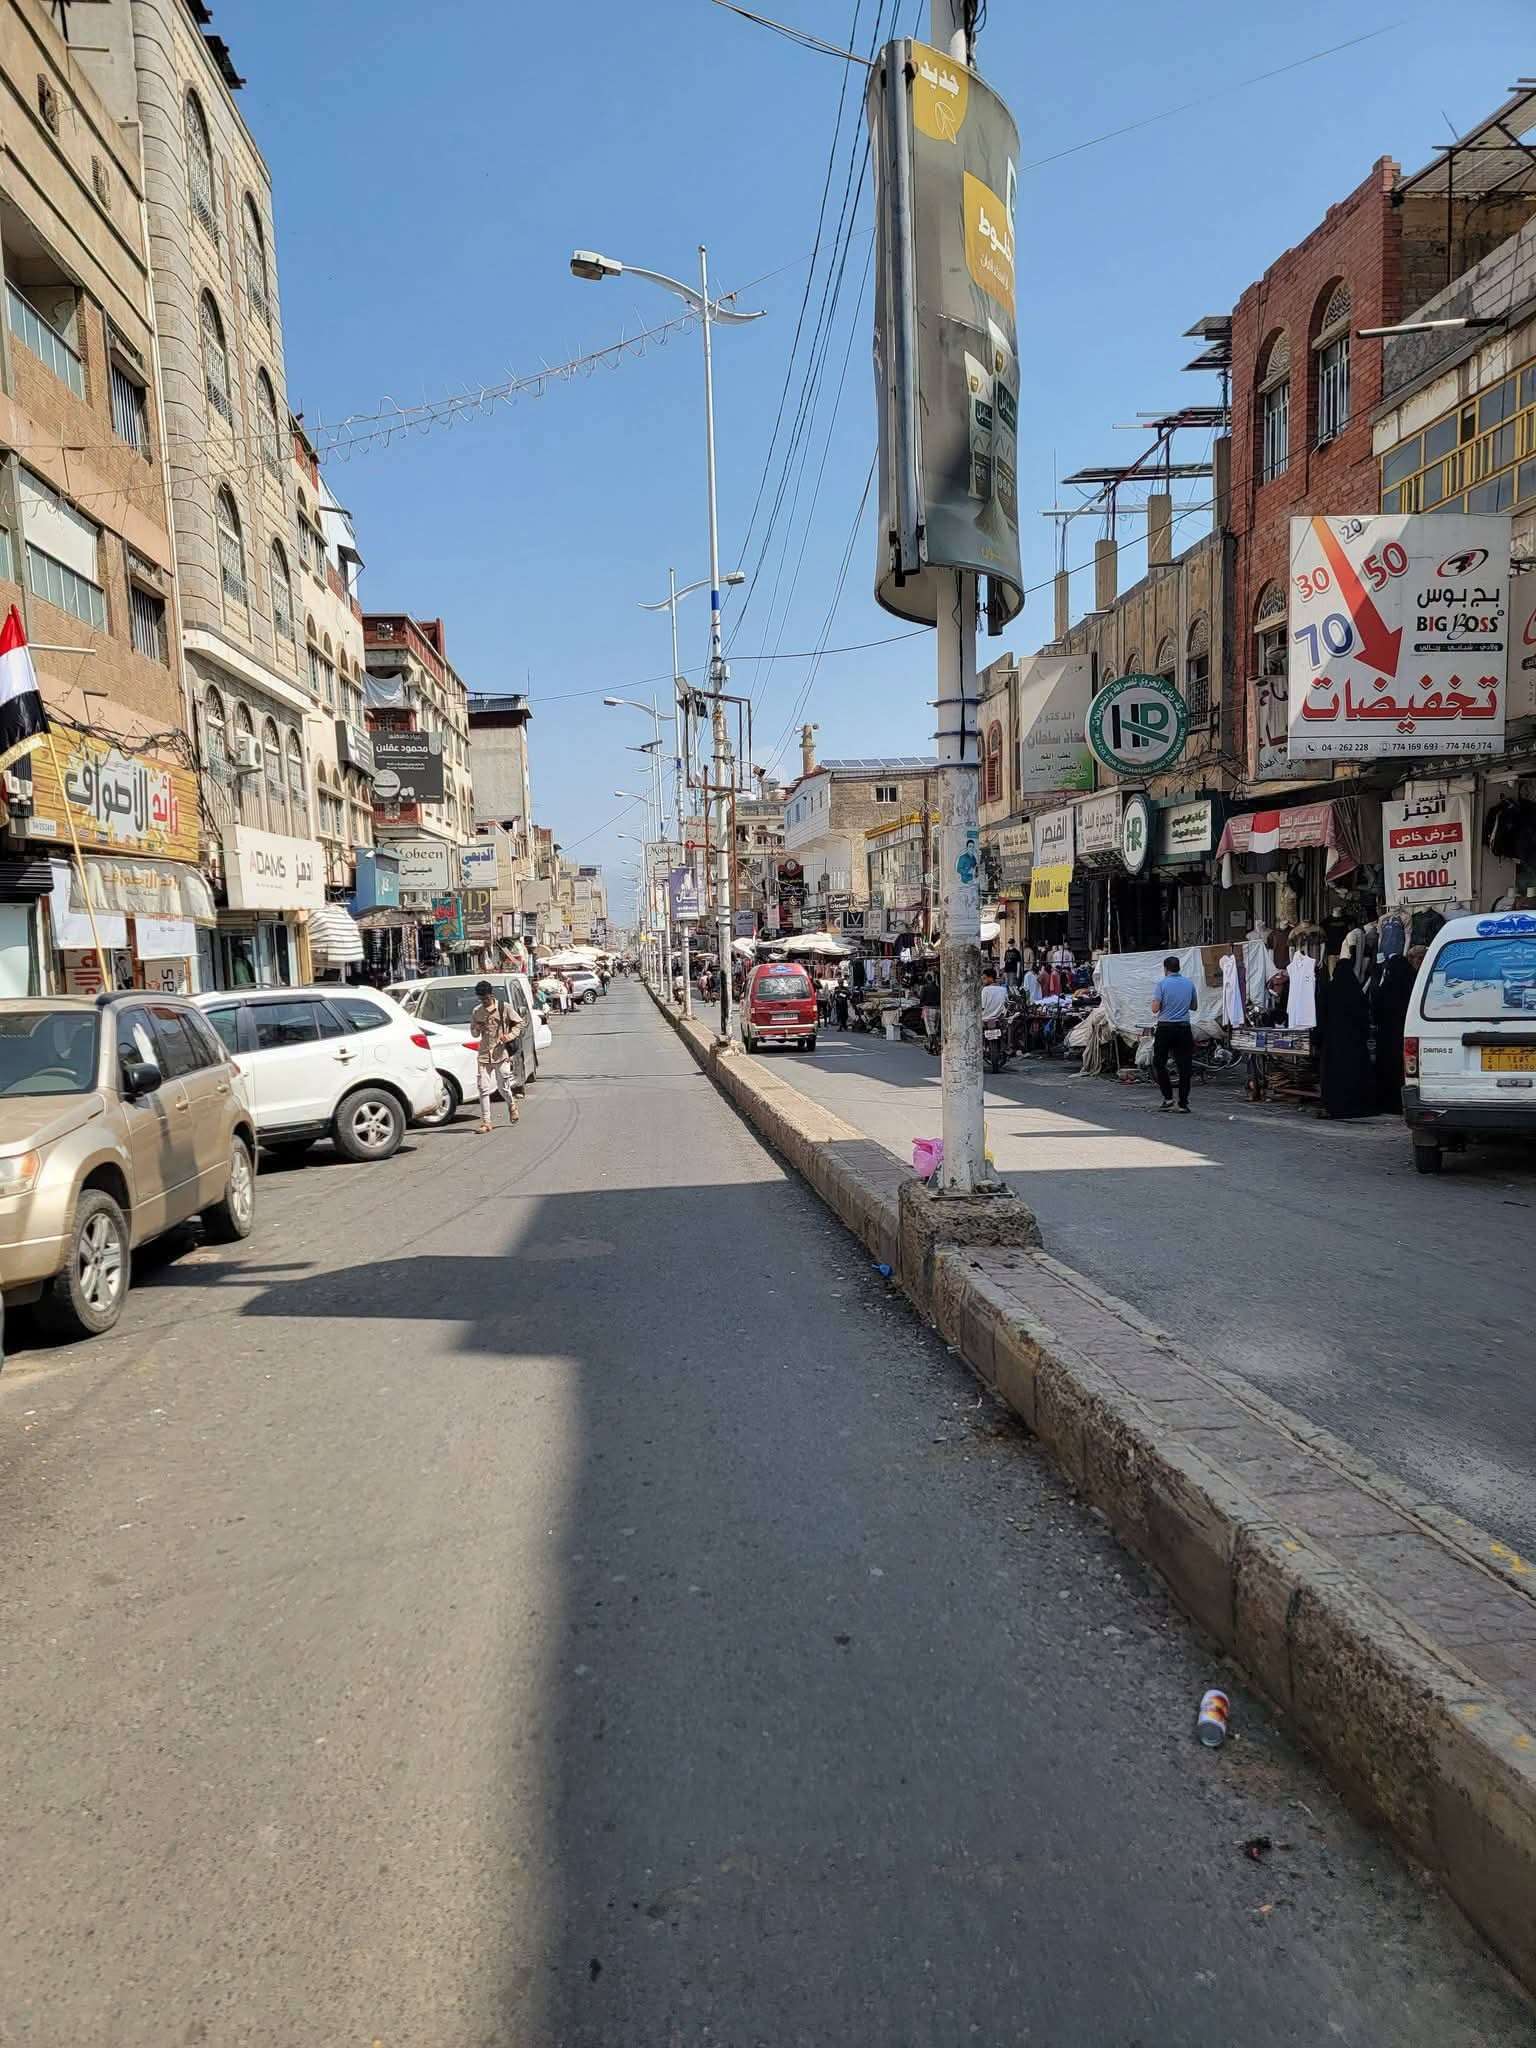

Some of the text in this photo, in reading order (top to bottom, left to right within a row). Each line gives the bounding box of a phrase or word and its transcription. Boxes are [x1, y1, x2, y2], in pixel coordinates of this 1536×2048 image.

[919, 60, 960, 98] جديد
[1341, 518, 1362, 541] 20
[1363, 542, 1408, 590] 50
[1296, 566, 1330, 599] 30
[1416, 588, 1467, 609] بوس
[1416, 613, 1499, 640] BIG BOSS
[1294, 613, 1354, 668] 70
[1302, 674, 1500, 734] تخفيضات
[375, 744, 428, 754] محمود عقلان
[1321, 743, 1333, 751] 04
[1339, 743, 1354, 751] 262
[1355, 742, 1369, 751] 228
[1392, 742, 1407, 751] 774
[1407, 742, 1422, 751] 169
[1445, 742, 1459, 751] 774
[1460, 742, 1476, 751] 746
[1477, 741, 1492, 750] 174
[1402, 800, 1446, 821] الجنز
[1395, 828, 1459, 845] عرض خاص
[250, 850, 286, 878] ADAMS
[397, 848, 443, 860] obeen
[1398, 850, 1438, 863] قطعة
[1398, 869, 1449, 890] 15000
